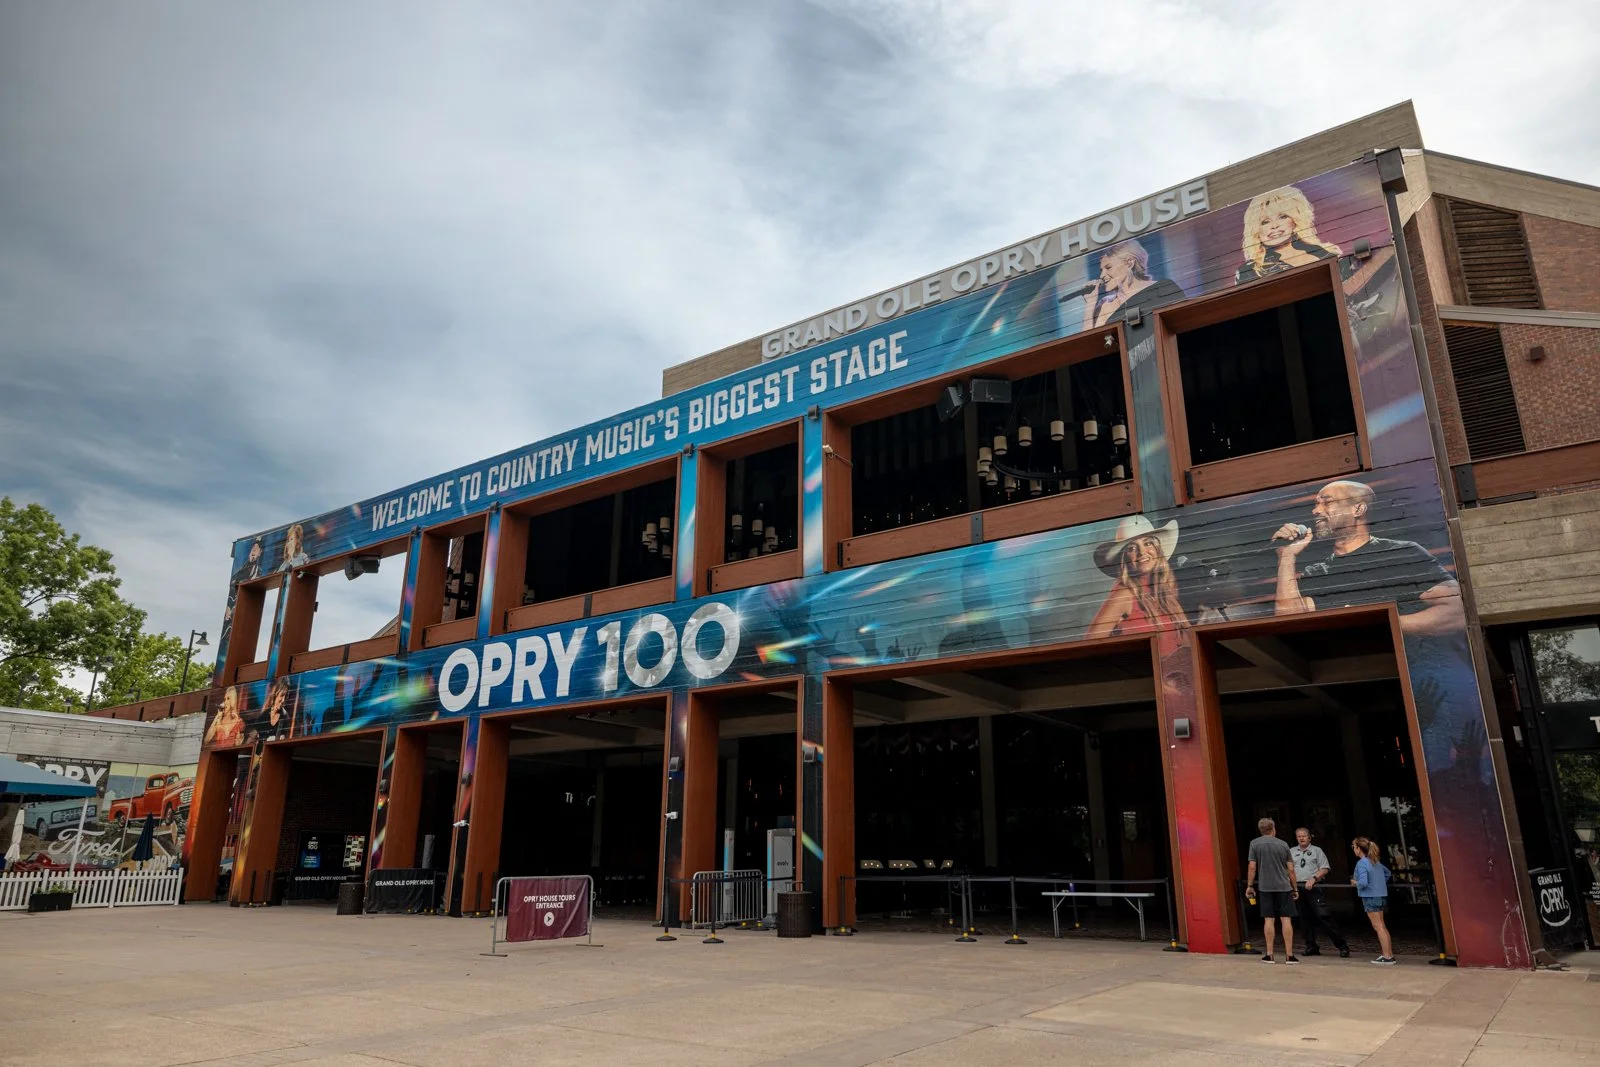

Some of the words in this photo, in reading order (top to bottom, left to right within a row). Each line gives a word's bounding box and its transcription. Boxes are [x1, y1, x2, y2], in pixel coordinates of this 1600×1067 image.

[762, 305, 868, 358] GRAND
[876, 278, 942, 321] OLE
[951, 235, 1052, 292] OPRY
[1060, 178, 1209, 258] HOUSE
[371, 478, 455, 532] WELCOME
[460, 472, 481, 505] TO
[486, 439, 578, 494] COUNTRY
[585, 407, 679, 467] MUSIC'S
[688, 365, 799, 435] BIGGEST
[810, 330, 909, 395] STAGE
[438, 626, 589, 712] OPRY
[596, 602, 741, 692] 100
[24, 761, 107, 787] RY
[1537, 874, 1553, 886] GRAND
[1540, 886, 1566, 914] OPRY
